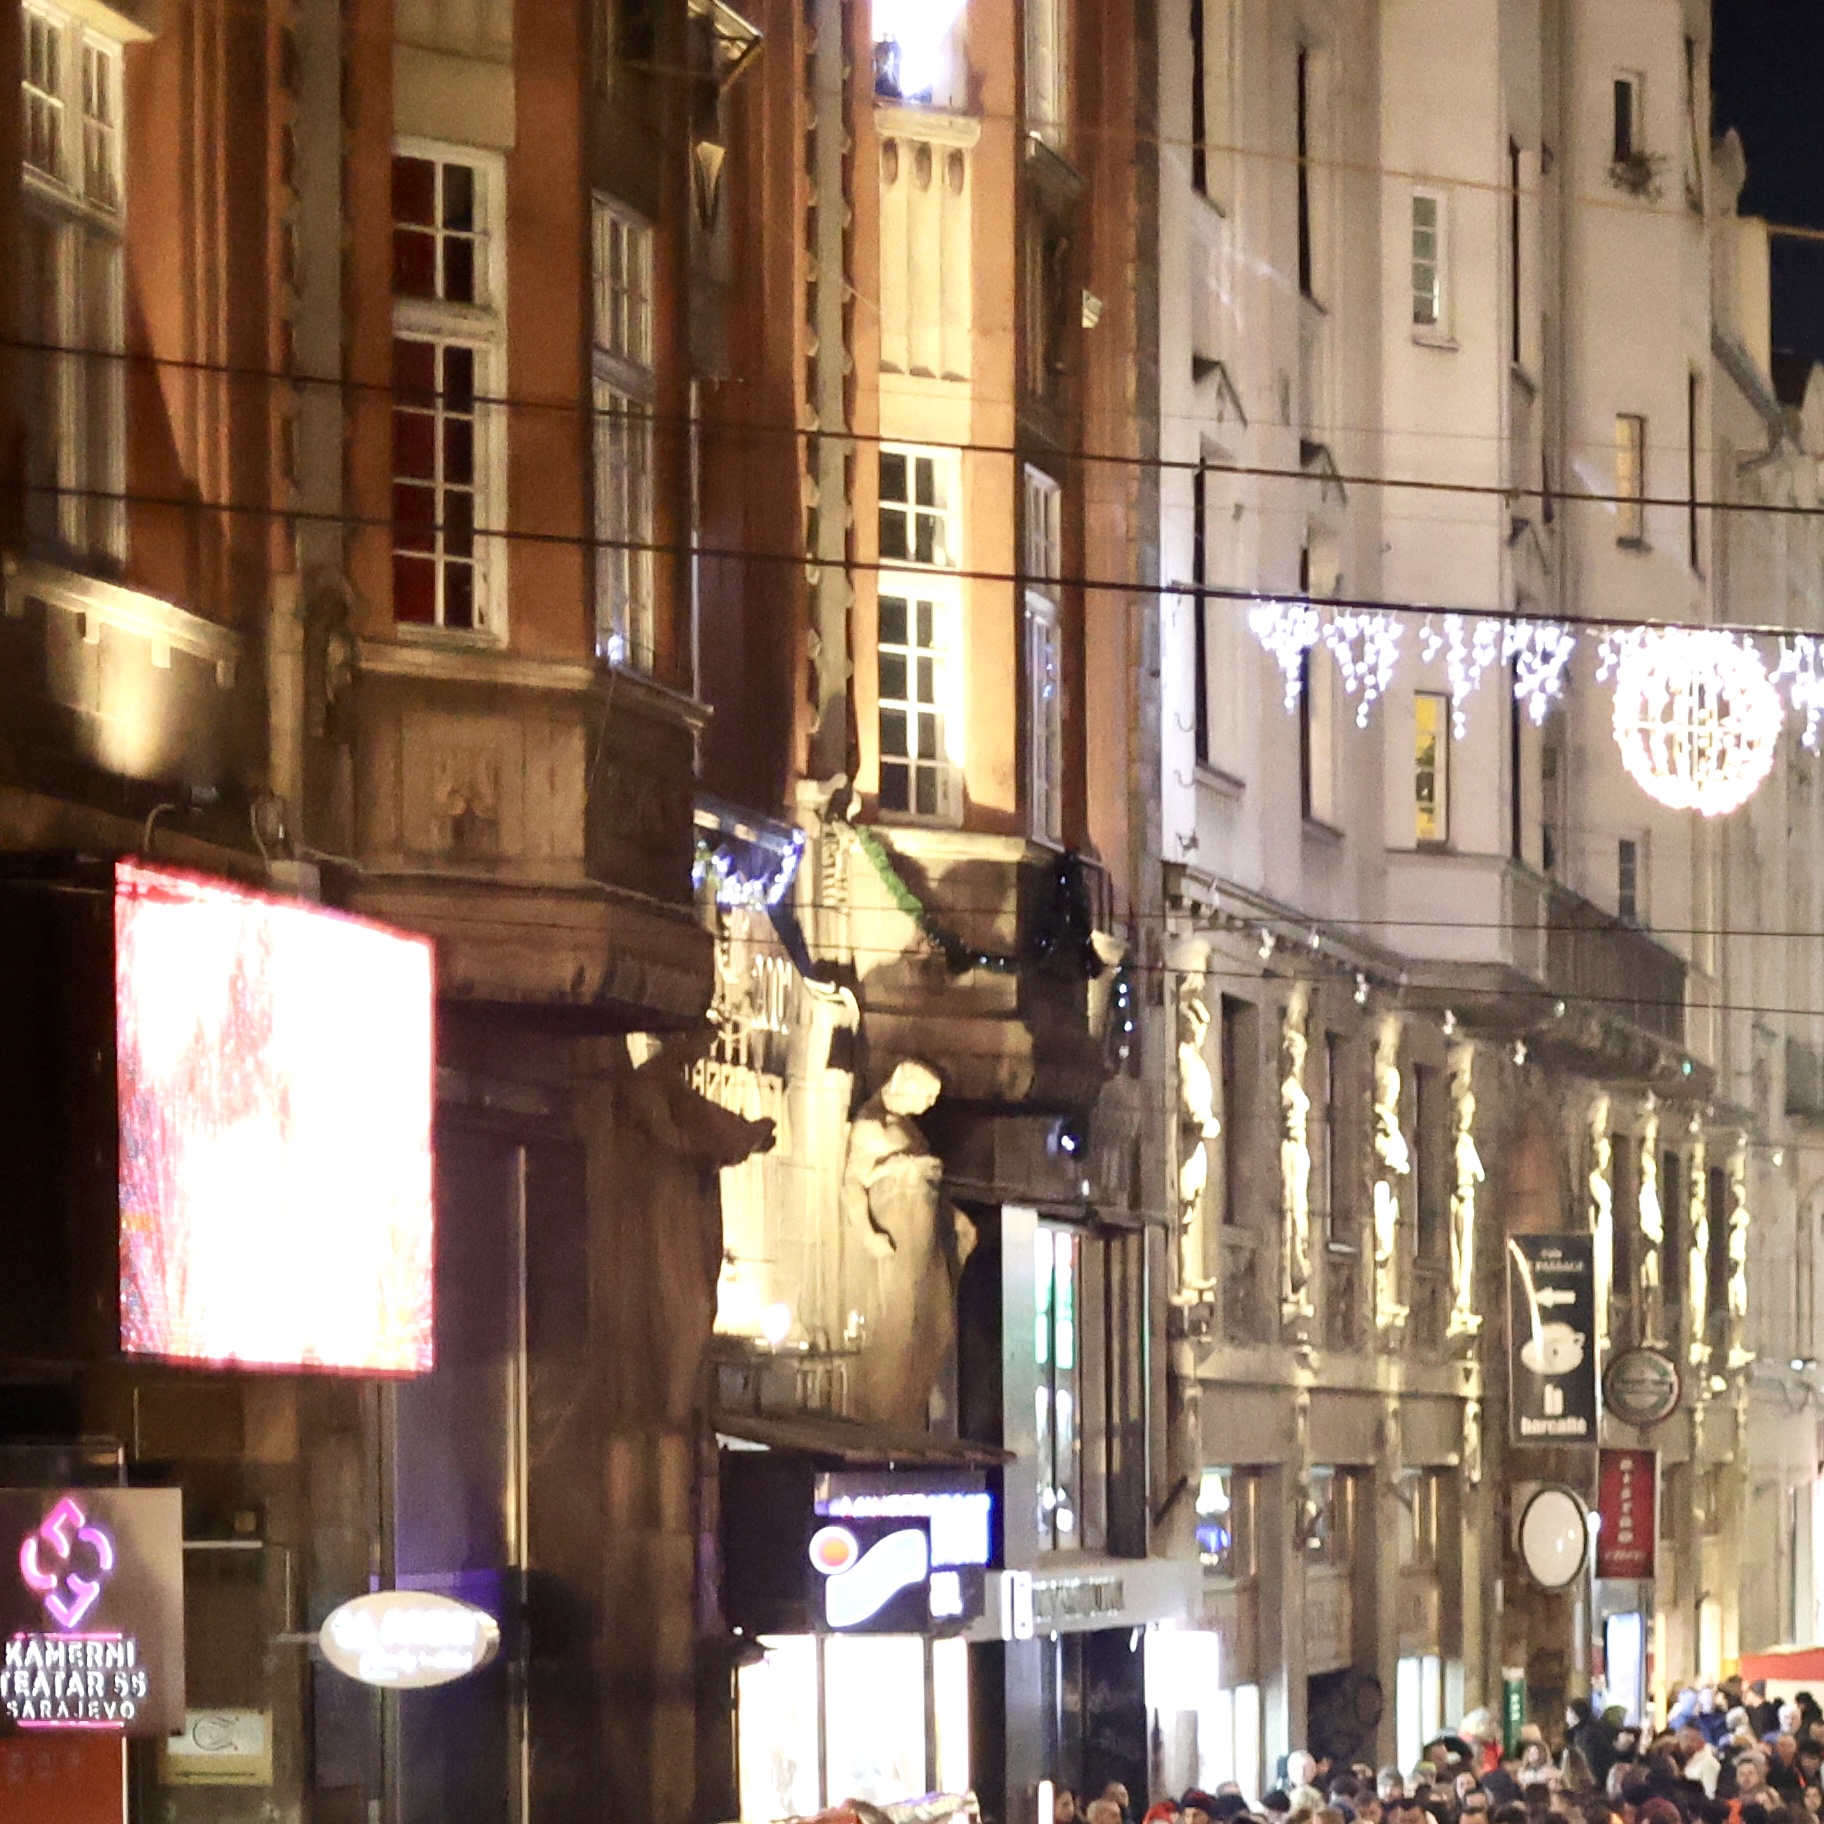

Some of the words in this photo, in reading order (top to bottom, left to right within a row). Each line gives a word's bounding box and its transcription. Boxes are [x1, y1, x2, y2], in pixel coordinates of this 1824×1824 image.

[5, 1640, 135, 1668] KAMERNI
[0, 1670, 105, 1698] TEATAR
[114, 1670, 147, 1698] 55
[6, 1699, 135, 1720] SARAJEVO
